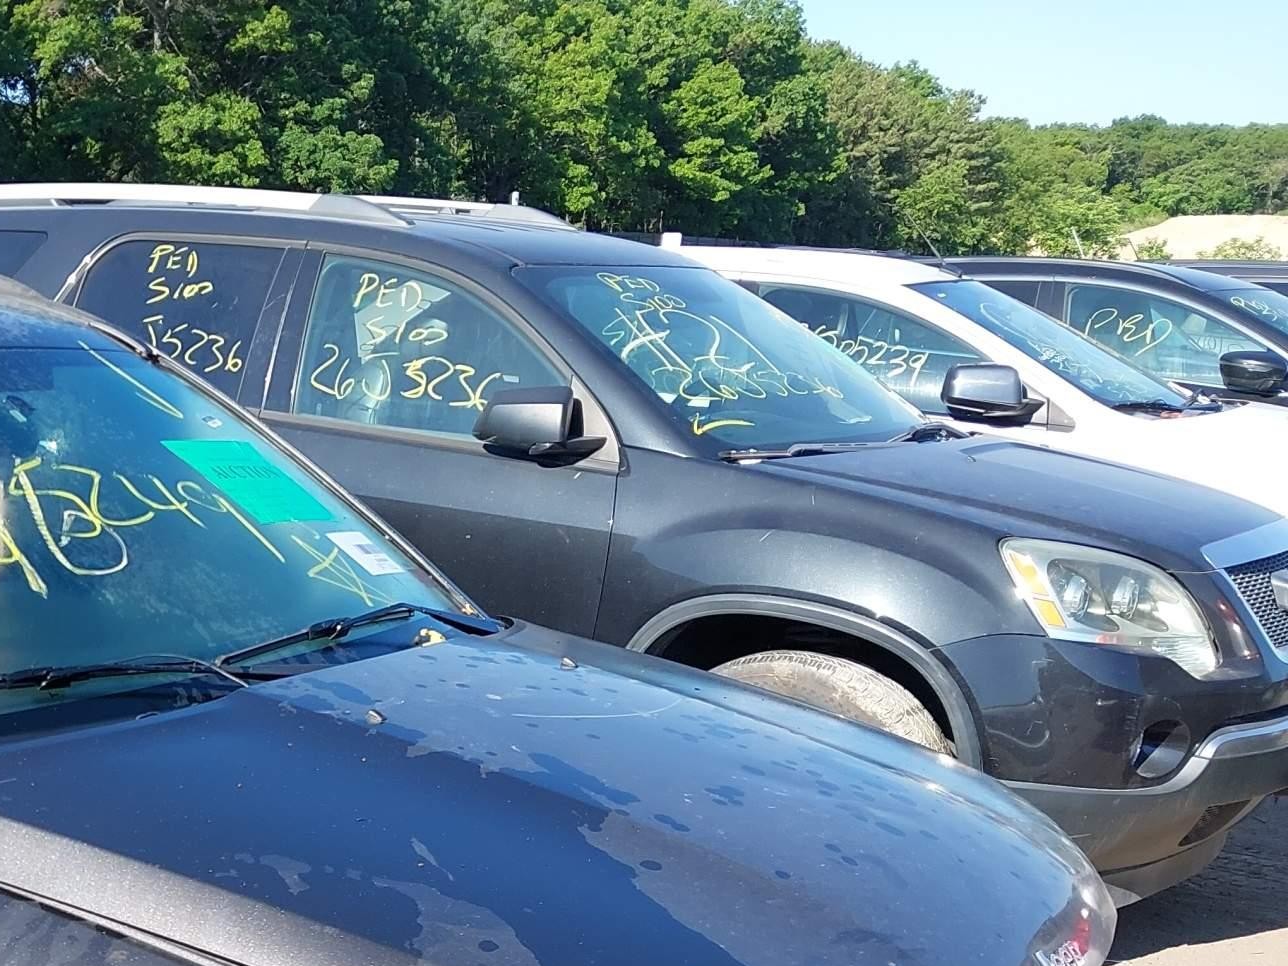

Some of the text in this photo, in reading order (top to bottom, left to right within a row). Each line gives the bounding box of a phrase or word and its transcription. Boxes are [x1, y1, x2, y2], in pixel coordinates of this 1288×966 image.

[148, 244, 199, 275] PED
[145, 278, 214, 305] S100
[353, 272, 423, 308] PED
[365, 319, 448, 346] S100
